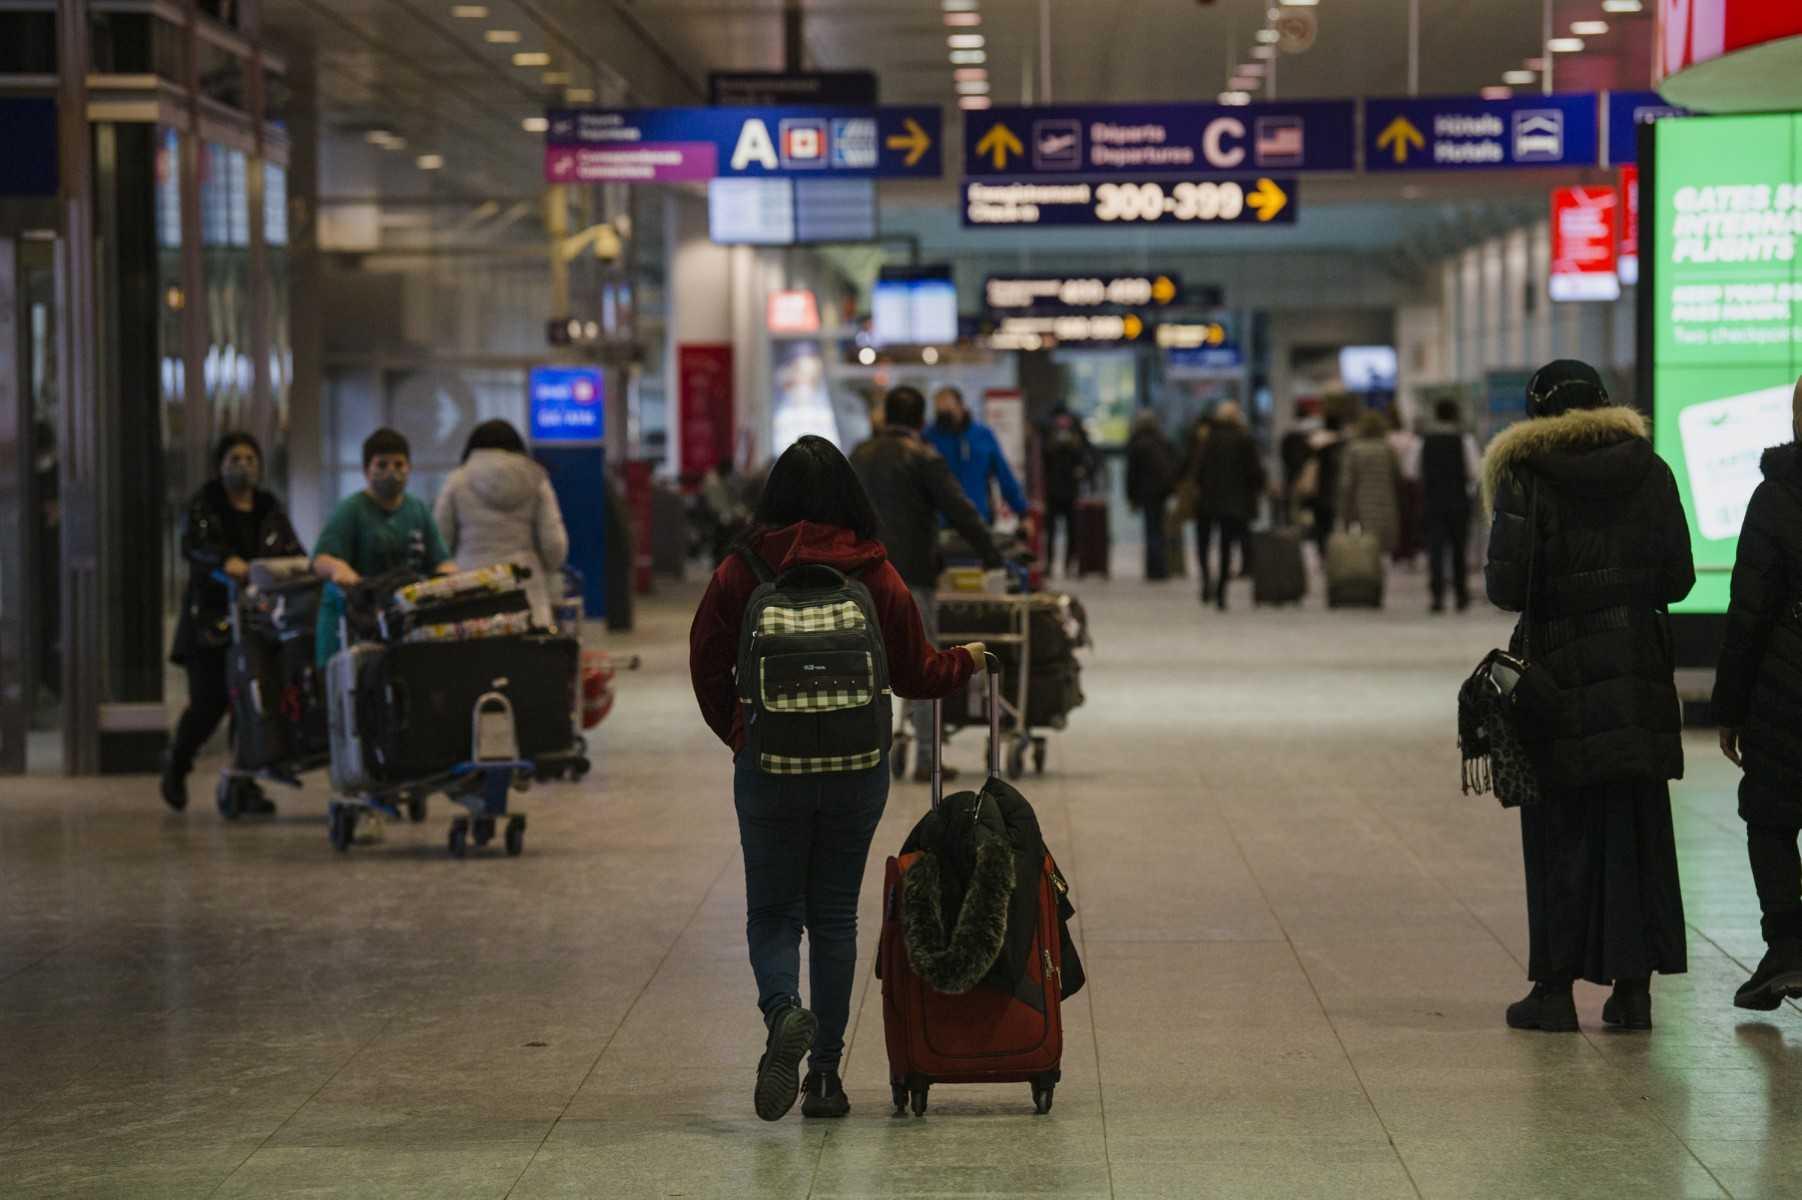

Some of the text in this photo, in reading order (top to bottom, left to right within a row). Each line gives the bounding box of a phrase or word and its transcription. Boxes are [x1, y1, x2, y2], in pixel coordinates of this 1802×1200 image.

[731, 118, 779, 170] A
[1090, 144, 1194, 167] Departures
[1203, 117, 1246, 168] C
[1433, 139, 1503, 163] Hotels
[1095, 182, 1243, 221] 300-399
[1674, 184, 1771, 210] GATES
[1671, 236, 1794, 262] FLIGHTS
